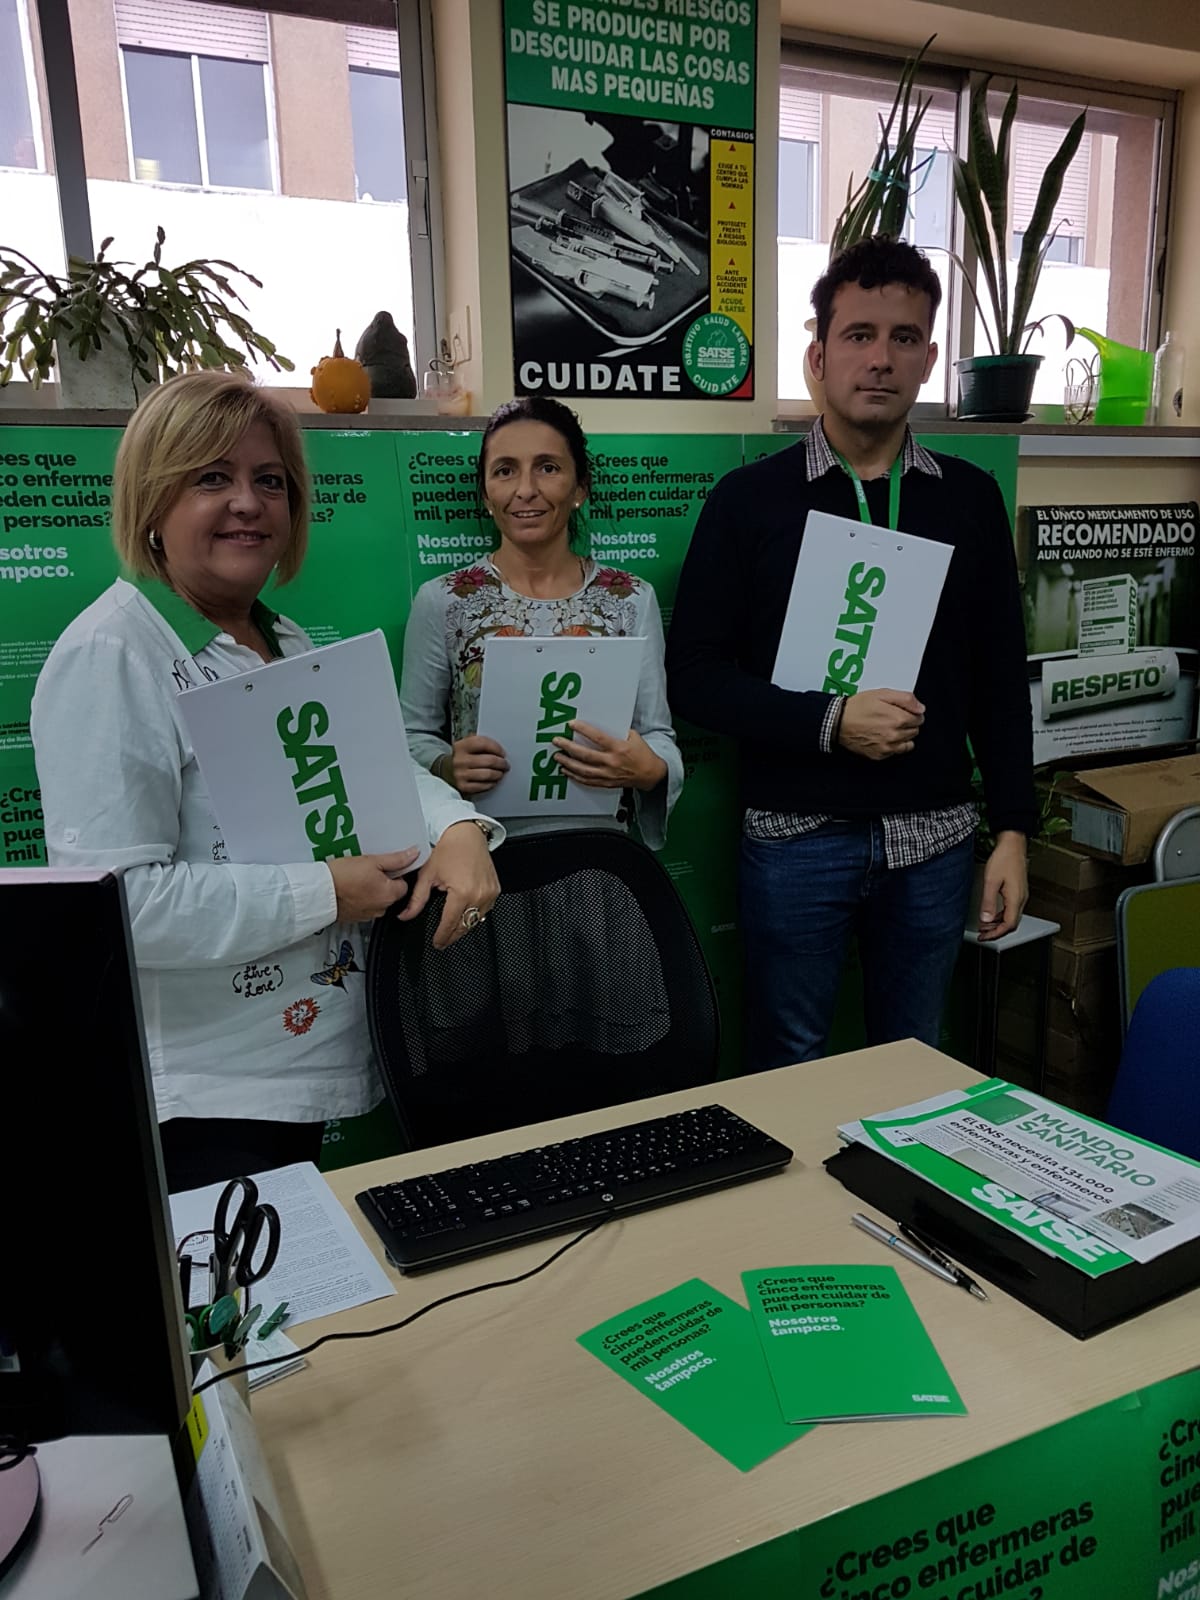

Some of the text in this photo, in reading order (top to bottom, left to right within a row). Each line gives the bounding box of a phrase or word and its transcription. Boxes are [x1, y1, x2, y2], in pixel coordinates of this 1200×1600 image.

[533, 1, 730, 53] SE PRODUCEN POR
[510, 28, 750, 85] DESCUIDAR LAS COSAS
[551, 66, 714, 109] MAS PEQUEÑAS
[711, 128, 755, 141] CONTAGIOS
[703, 315, 730, 327] SALUD
[698, 346, 736, 359] SATSE
[519, 361, 681, 392] CUIDATE
[693, 373, 740, 393] CUIDATE
[34, 453, 77, 470] que
[408, 452, 465, 470] ¿Crees
[640, 455, 669, 471] que
[410, 469, 456, 485] cinco
[632, 469, 715, 485] enfermeras
[343, 487, 367, 504] de
[412, 487, 477, 506] pueden
[649, 486, 696, 501] cuidar
[414, 505, 442, 520] mil
[616, 504, 690, 523] personas?
[1036, 510, 1049, 521] EL
[1087, 509, 1159, 520] MEDICAMENTO
[1161, 509, 1173, 519] DE
[1174, 509, 1195, 520] USO
[416, 533, 493, 549] Nosotros
[590, 531, 658, 547] Nosotros
[1038, 521, 1196, 546] RECOMENDADO
[591, 547, 661, 564] tampoco.
[1037, 544, 1196, 561] AUN CUANDO NO SE ESTÉ ENFERMO
[1051, 666, 1161, 705] RESPETO
[5, 843, 41, 863] mil
[1031, 1112, 1135, 1161] MUNDO
[950, 1121, 1022, 1160] enfermeras
[1030, 1162, 1113, 1205] enfermeros
[962, 1116, 1115, 1193] El SNS necesita 131.000
[1016, 1121, 1156, 1187] SANITARIO
[971, 1183, 1120, 1263] SATSE
[757, 1274, 836, 1290] ¿Crees que
[758, 1282, 886, 1297] cinco enfermeras
[761, 1290, 891, 1307] pueden cuidar de
[764, 1299, 865, 1314] mil personas?
[601, 1311, 667, 1350] ¿Crees que
[609, 1300, 713, 1356] cinco enfermeras
[768, 1315, 839, 1329] Nosotros
[771, 1323, 846, 1337] tampoco.
[619, 1306, 723, 1366] pueden cuidar de
[630, 1323, 712, 1372] mil personas?
[644, 1349, 704, 1385] Nosotros
[654, 1357, 718, 1392] tampoco.
[1160, 1510, 1196, 1554] mil
[820, 1528, 930, 1599] ¿Crees
[935, 1503, 996, 1547] que
[918, 1501, 1094, 1589] enfermeras
[1059, 1536, 1098, 1567] de
